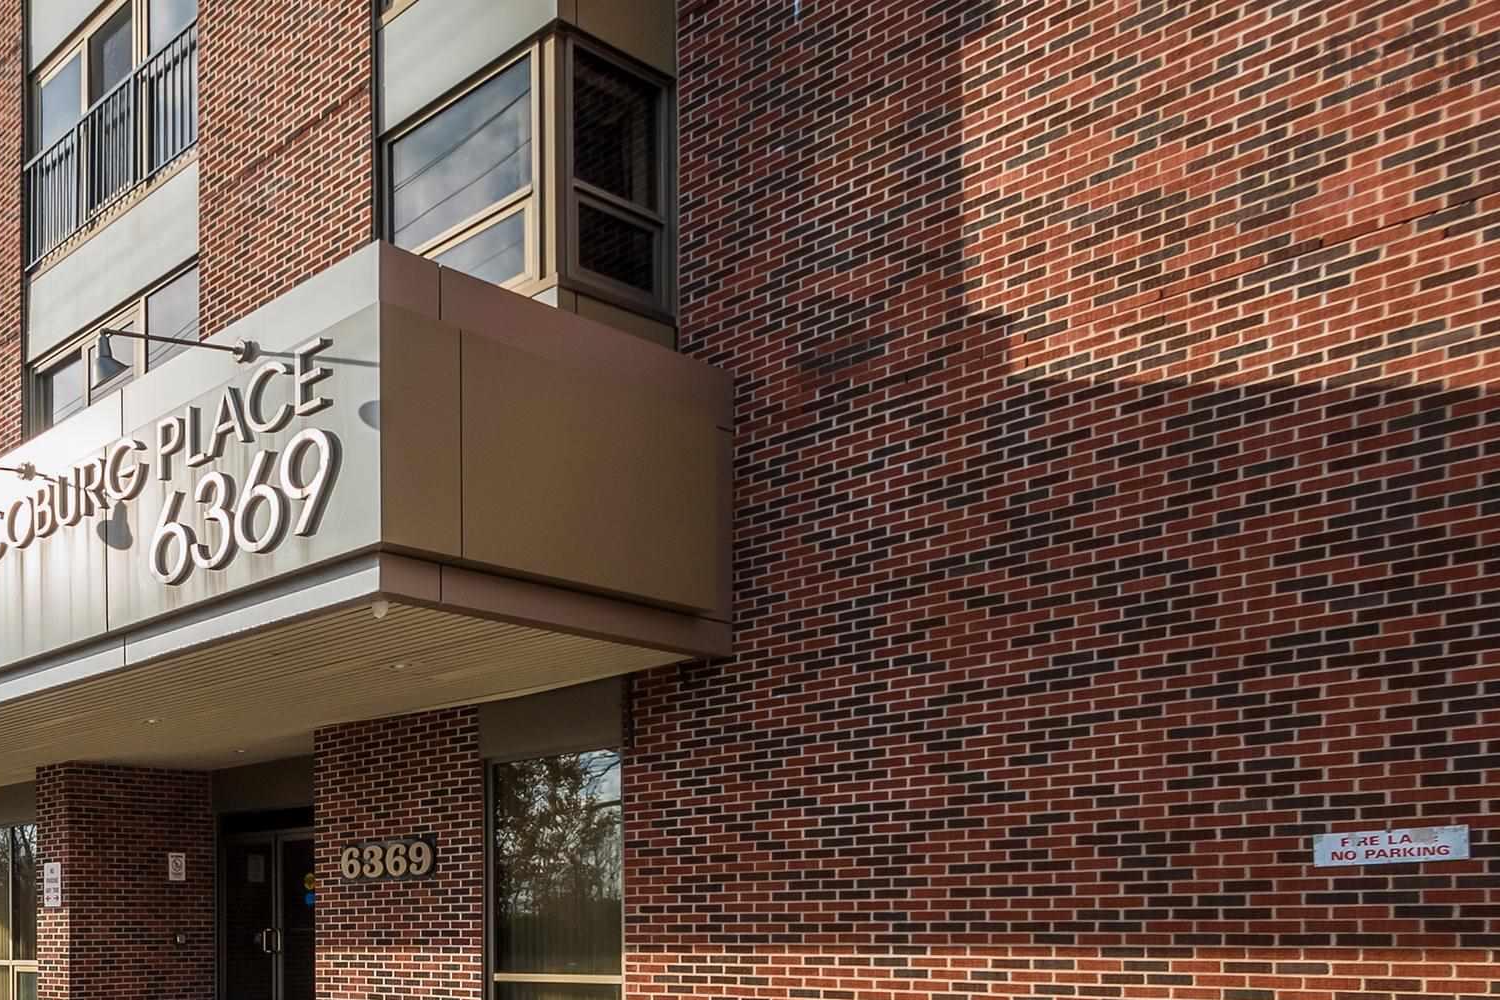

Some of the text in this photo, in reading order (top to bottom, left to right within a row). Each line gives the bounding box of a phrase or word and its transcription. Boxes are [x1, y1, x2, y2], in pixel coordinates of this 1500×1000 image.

[156, 336, 334, 481] PLACE
[149, 428, 343, 586] 6369
[1331, 844, 1450, 861] NO PARKING
[1340, 833, 1439, 848] FRE LA
[340, 841, 432, 879] 6369
